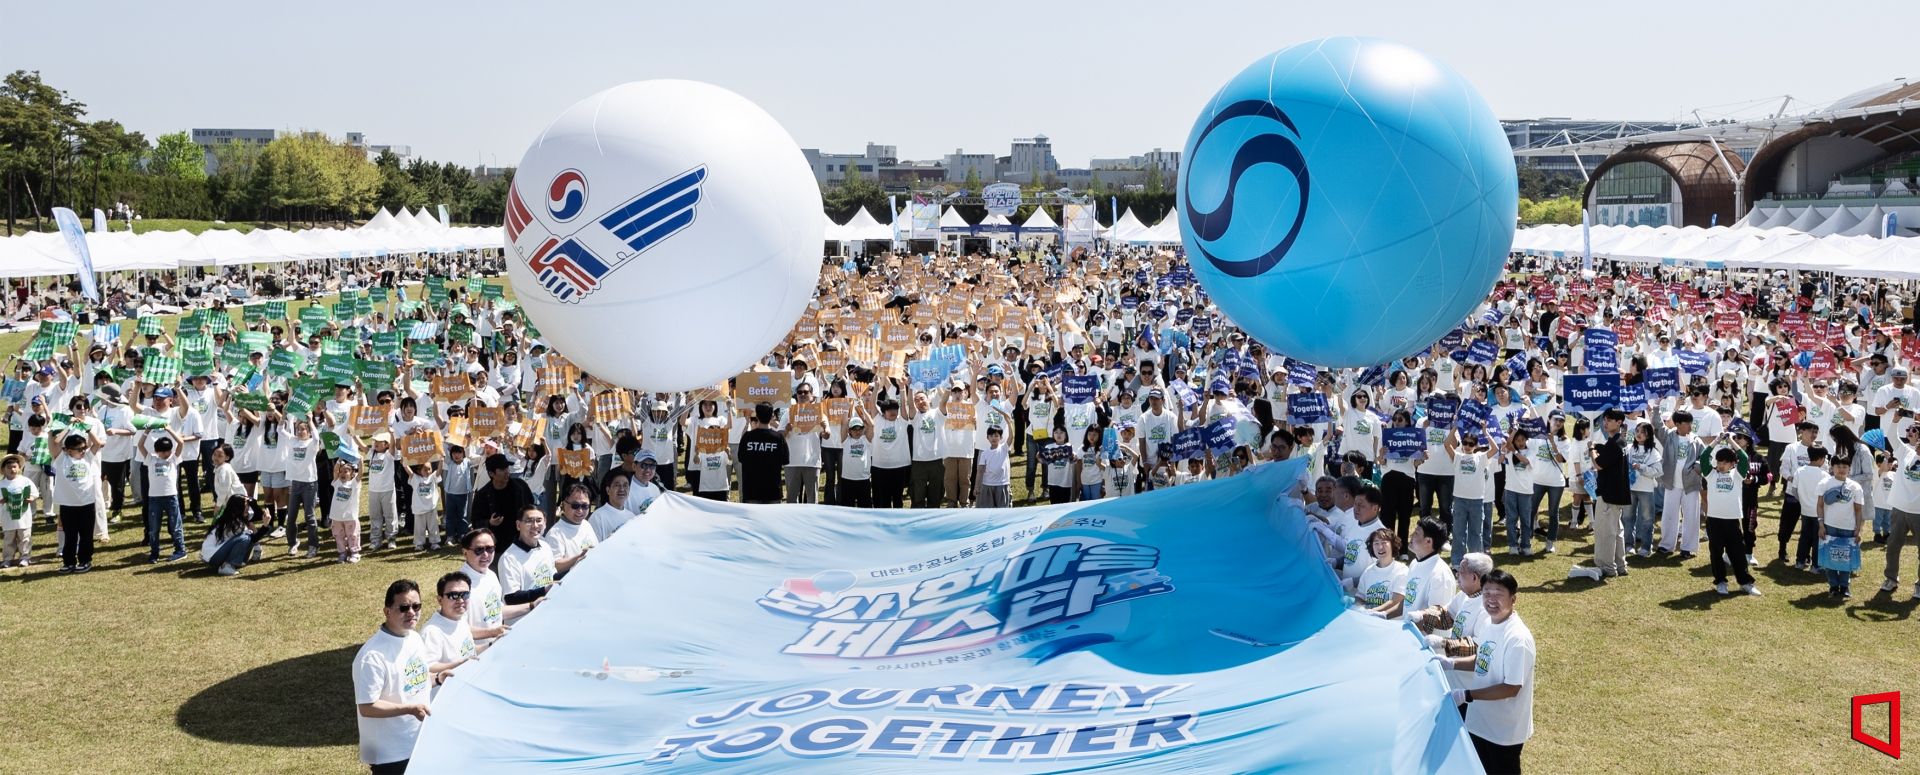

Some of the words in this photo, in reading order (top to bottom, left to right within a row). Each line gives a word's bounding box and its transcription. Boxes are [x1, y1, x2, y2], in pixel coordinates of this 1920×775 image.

[1588, 338, 1615, 346] Together
[1471, 346, 1494, 357] Together
[185, 358, 211, 366] Tomorrow
[271, 359, 296, 368] Tomorrow
[1588, 360, 1615, 368] Together
[323, 365, 354, 375] Tomorrow
[361, 371, 390, 379] Tomorrow
[1290, 371, 1313, 380] Together
[1648, 379, 1675, 388] Together
[439, 384, 465, 393] Better
[749, 387, 778, 395] Better
[1065, 386, 1092, 394] Together
[1571, 389, 1611, 398] Together
[357, 416, 383, 424] Better
[794, 414, 818, 422] Better
[747, 442, 777, 452] STAFF
[1176, 440, 1200, 450] Together
[1388, 439, 1422, 447] Together
[408, 444, 435, 454] Better
[871, 534, 1006, 579] 대한항공노동조합
[1011, 525, 1043, 541] 창립
[758, 543, 1161, 620] 노사한마음
[781, 574, 1110, 658] 페스타
[876, 648, 993, 672] 아시아나항공과
[687, 682, 1194, 729] JOURNEY
[648, 713, 1199, 764] TOGETHER
